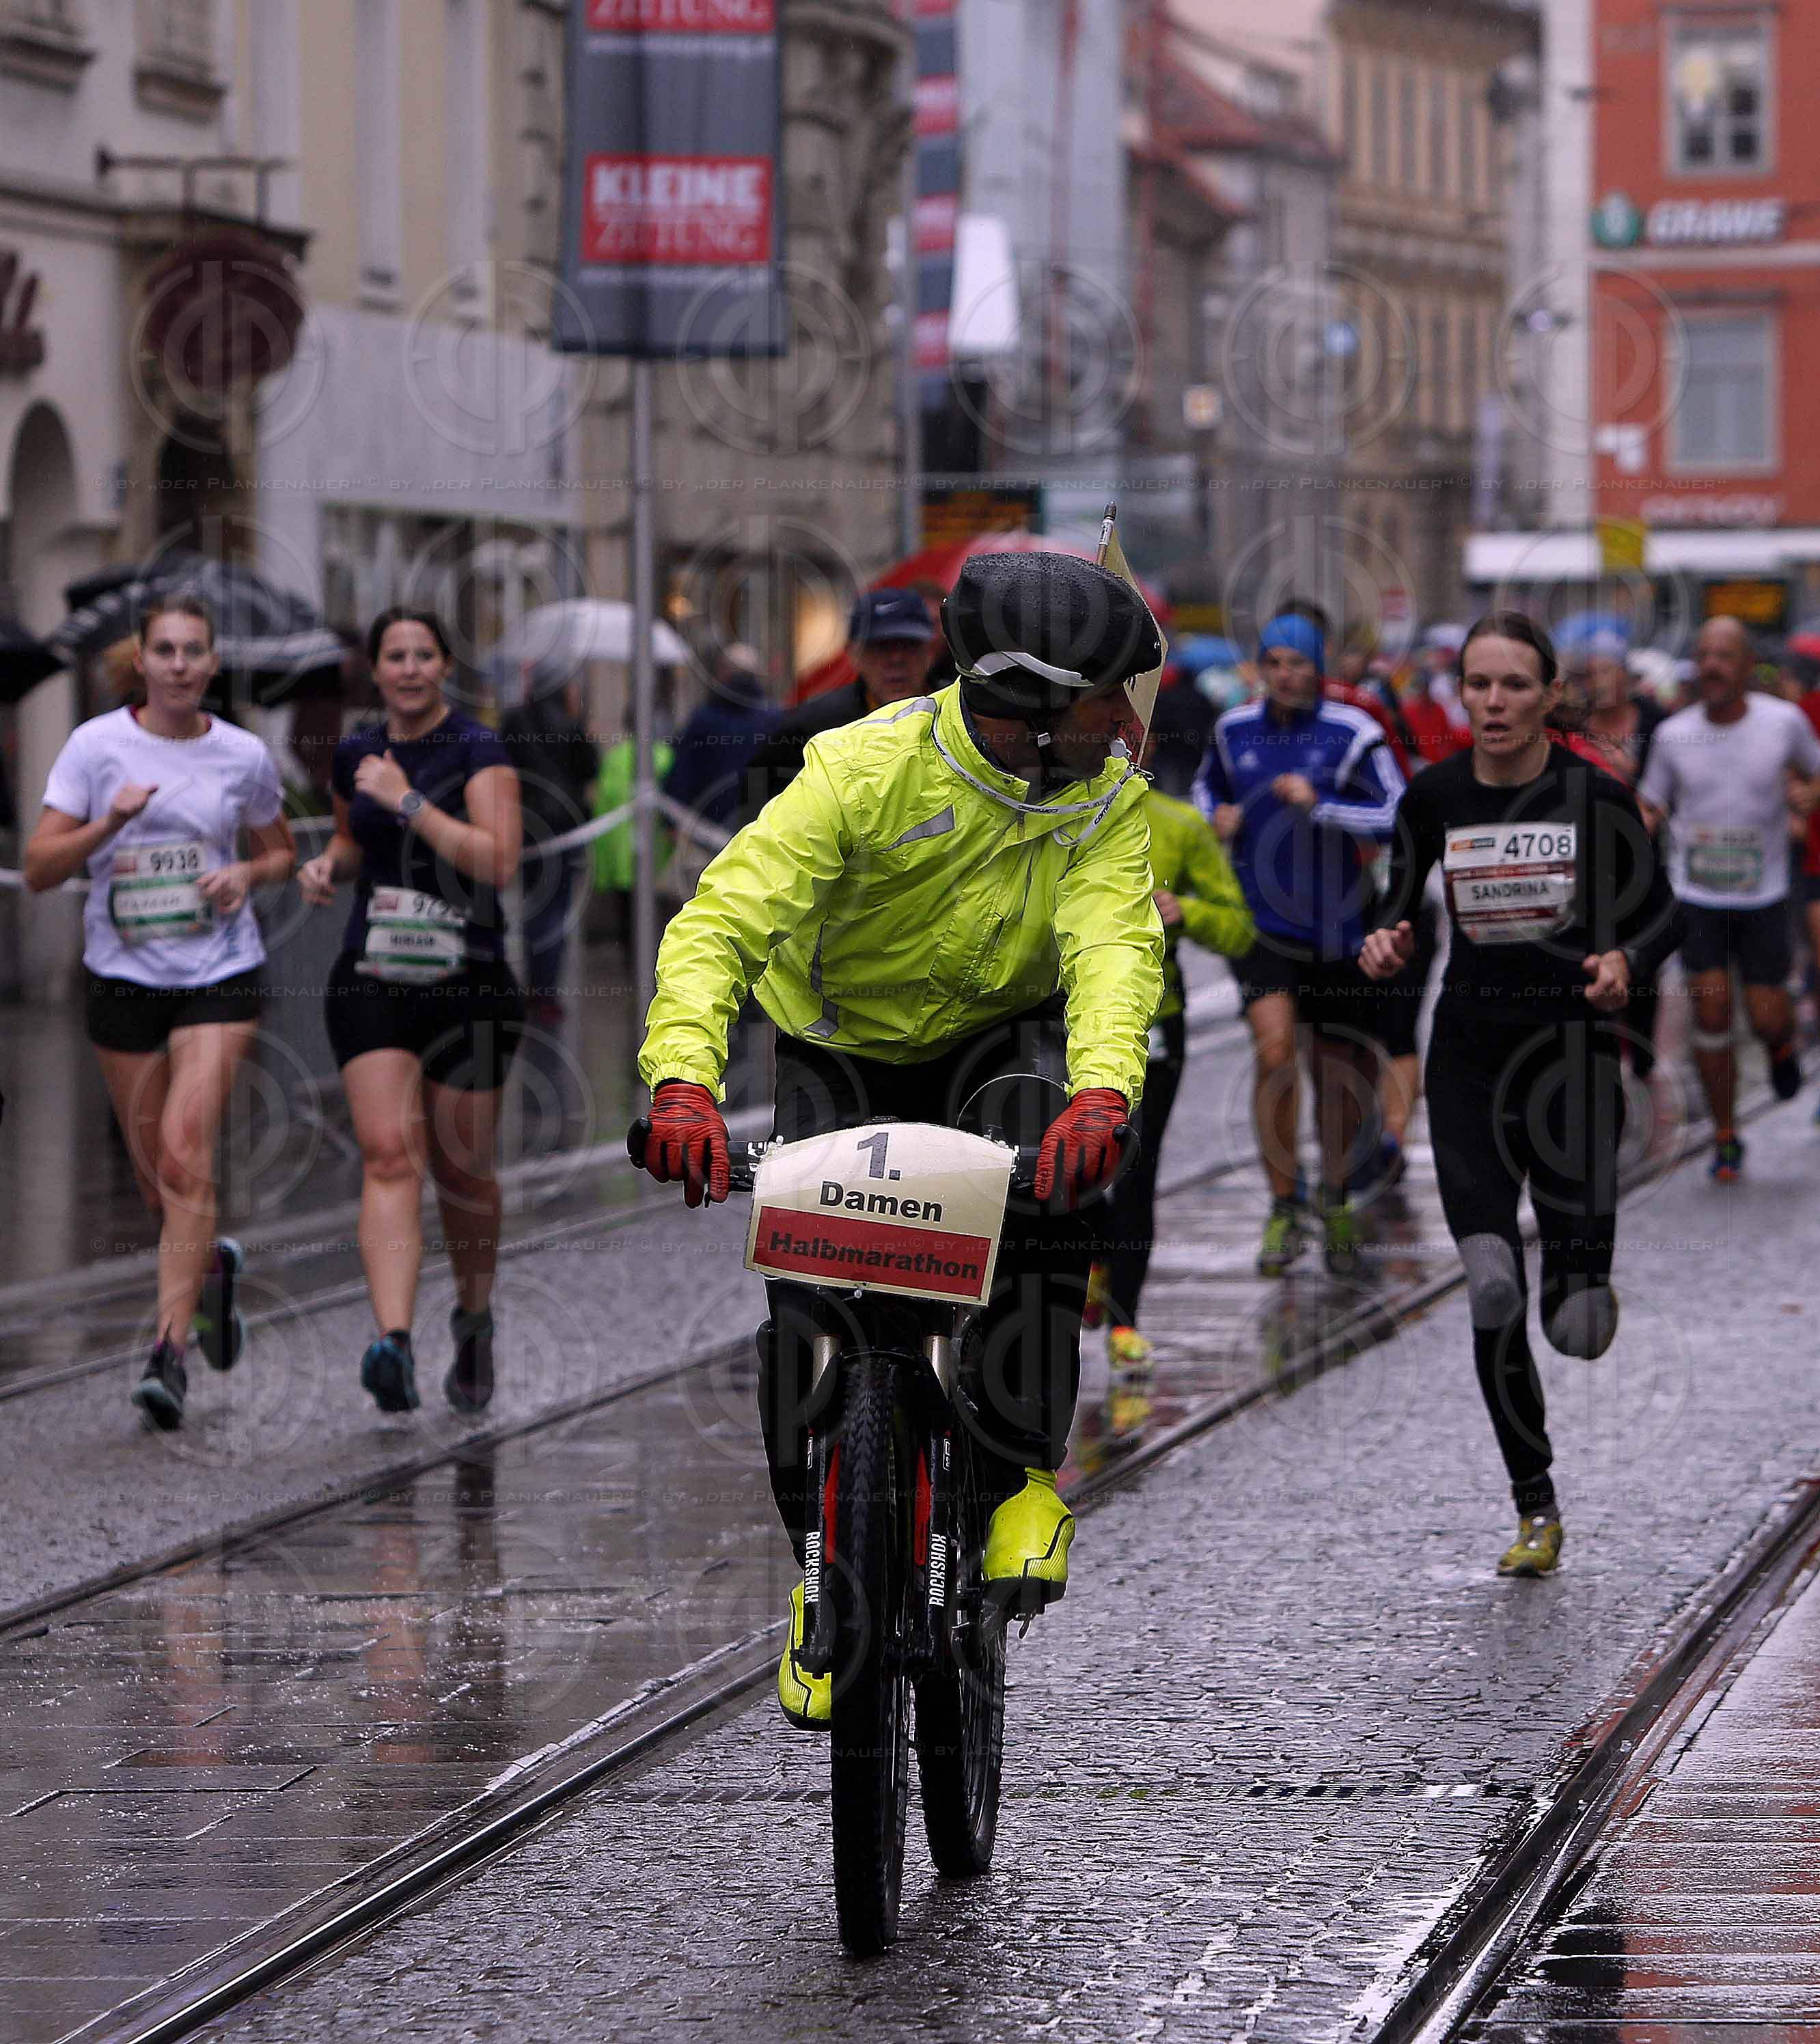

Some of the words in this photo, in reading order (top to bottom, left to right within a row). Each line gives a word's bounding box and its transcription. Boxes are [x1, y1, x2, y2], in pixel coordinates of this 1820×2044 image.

[592, 163, 764, 207] KLEINE
[1504, 833, 1571, 857] 4708
[1471, 881, 1549, 900] SANDRINA
[857, 1132, 901, 1181] 1.
[819, 1181, 943, 1222] Damen
[769, 1230, 978, 1280] Halbmarathon
[803, 1531, 821, 1604] ROCKSHOX
[928, 1533, 947, 1607] ROCKSHOX
